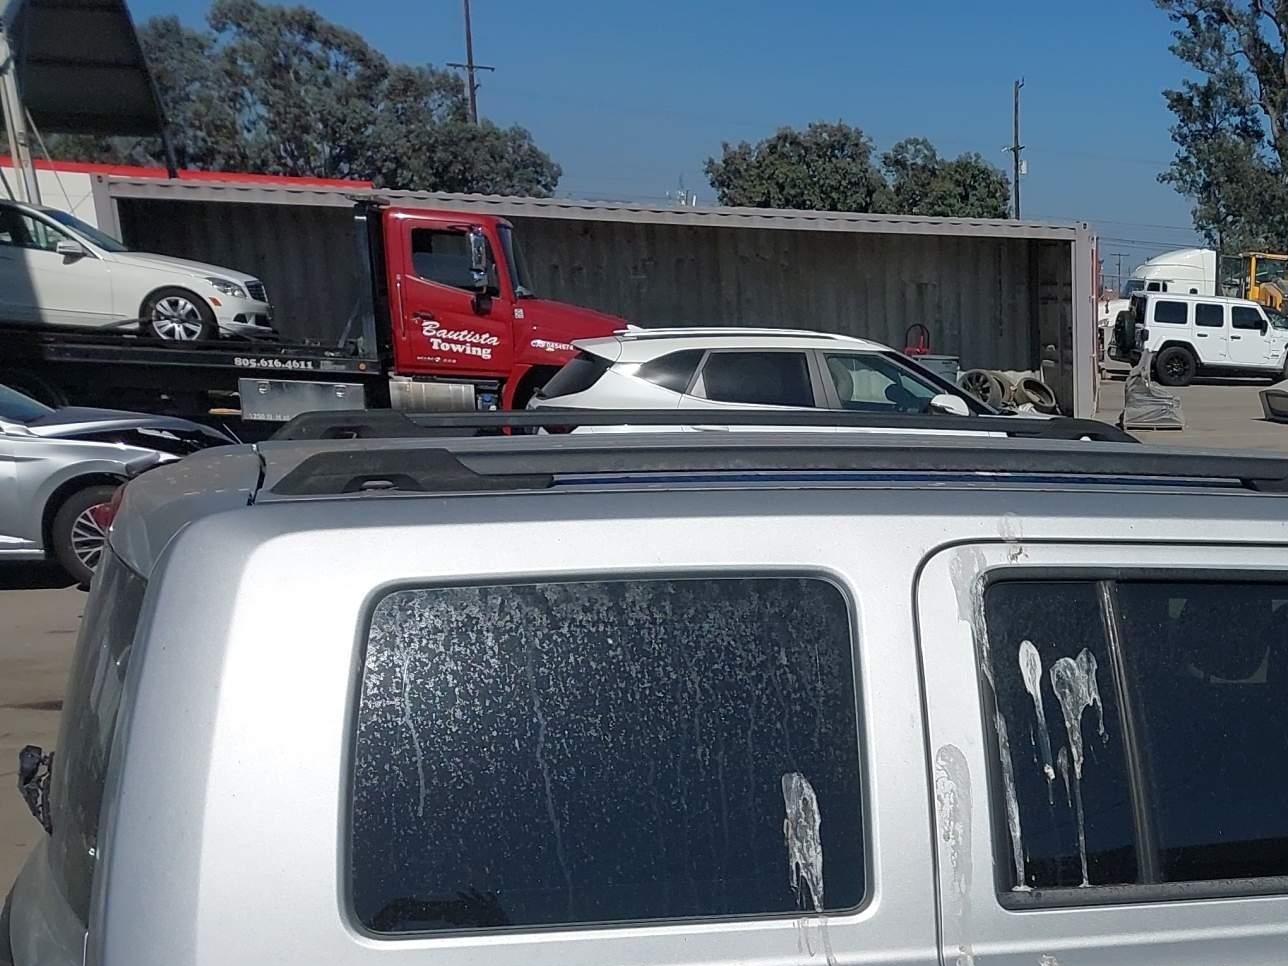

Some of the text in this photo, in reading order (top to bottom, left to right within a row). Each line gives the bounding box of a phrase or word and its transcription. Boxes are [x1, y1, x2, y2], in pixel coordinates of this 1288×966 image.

[421, 320, 501, 346] Bautista
[430, 338, 492, 360] Towing
[233, 357, 314, 370] 805.616.4611
